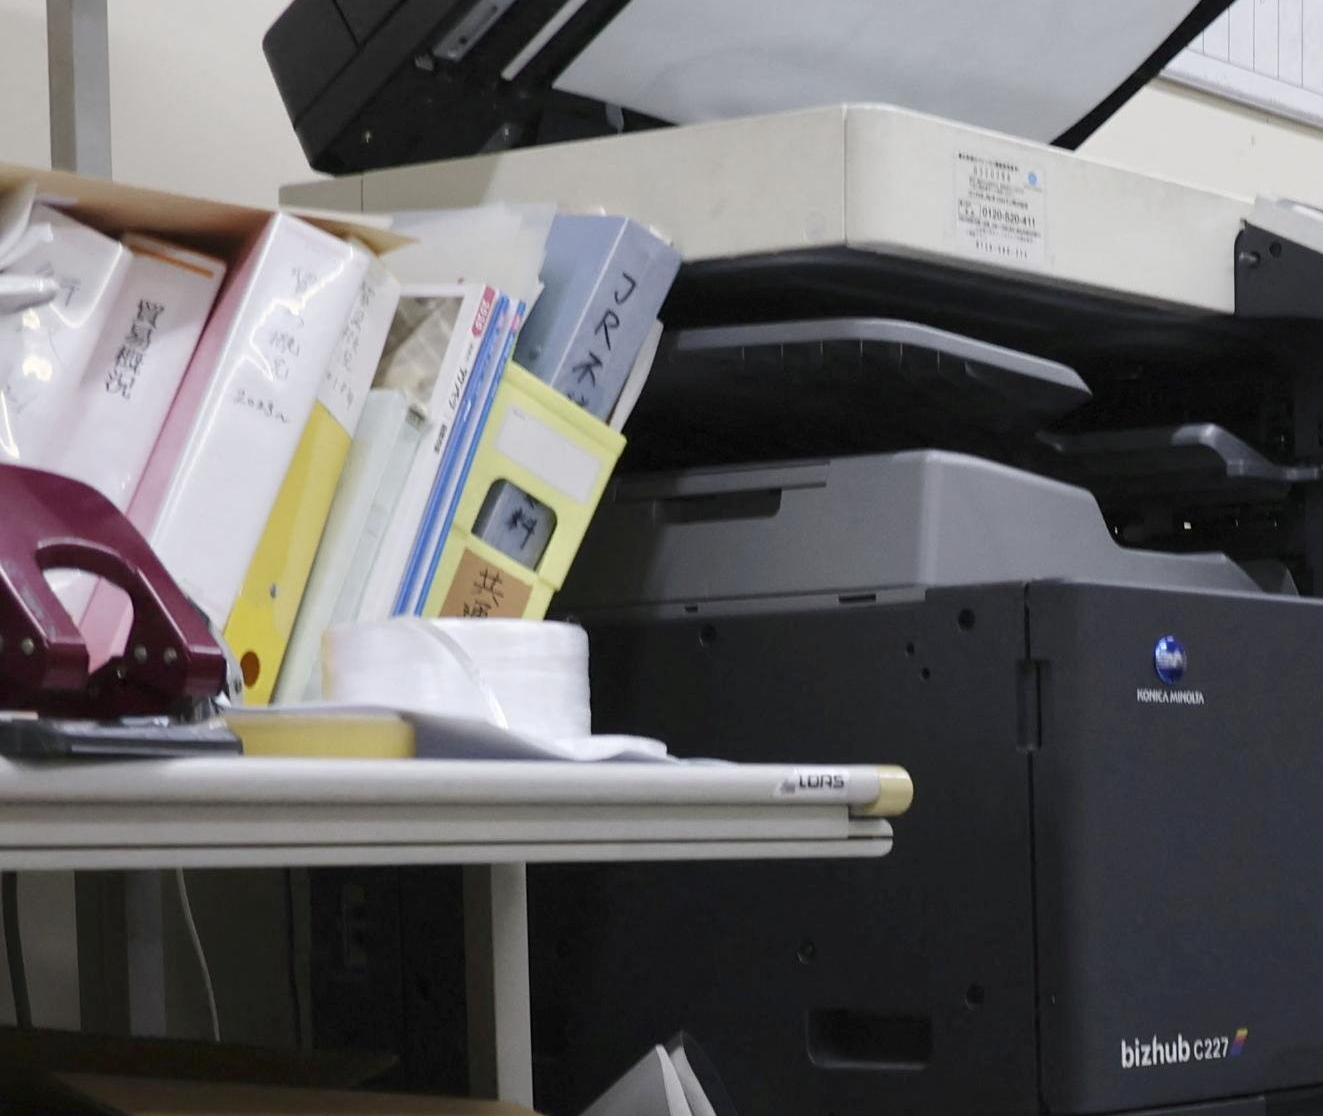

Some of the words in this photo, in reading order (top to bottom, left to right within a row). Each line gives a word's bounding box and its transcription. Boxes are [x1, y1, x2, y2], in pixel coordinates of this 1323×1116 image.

[1136, 688, 1169, 704] KONICA
[1170, 690, 1205, 705] MINOLTA
[1120, 1030, 1190, 1069] bizhub
[1193, 1036, 1229, 1062] C227
